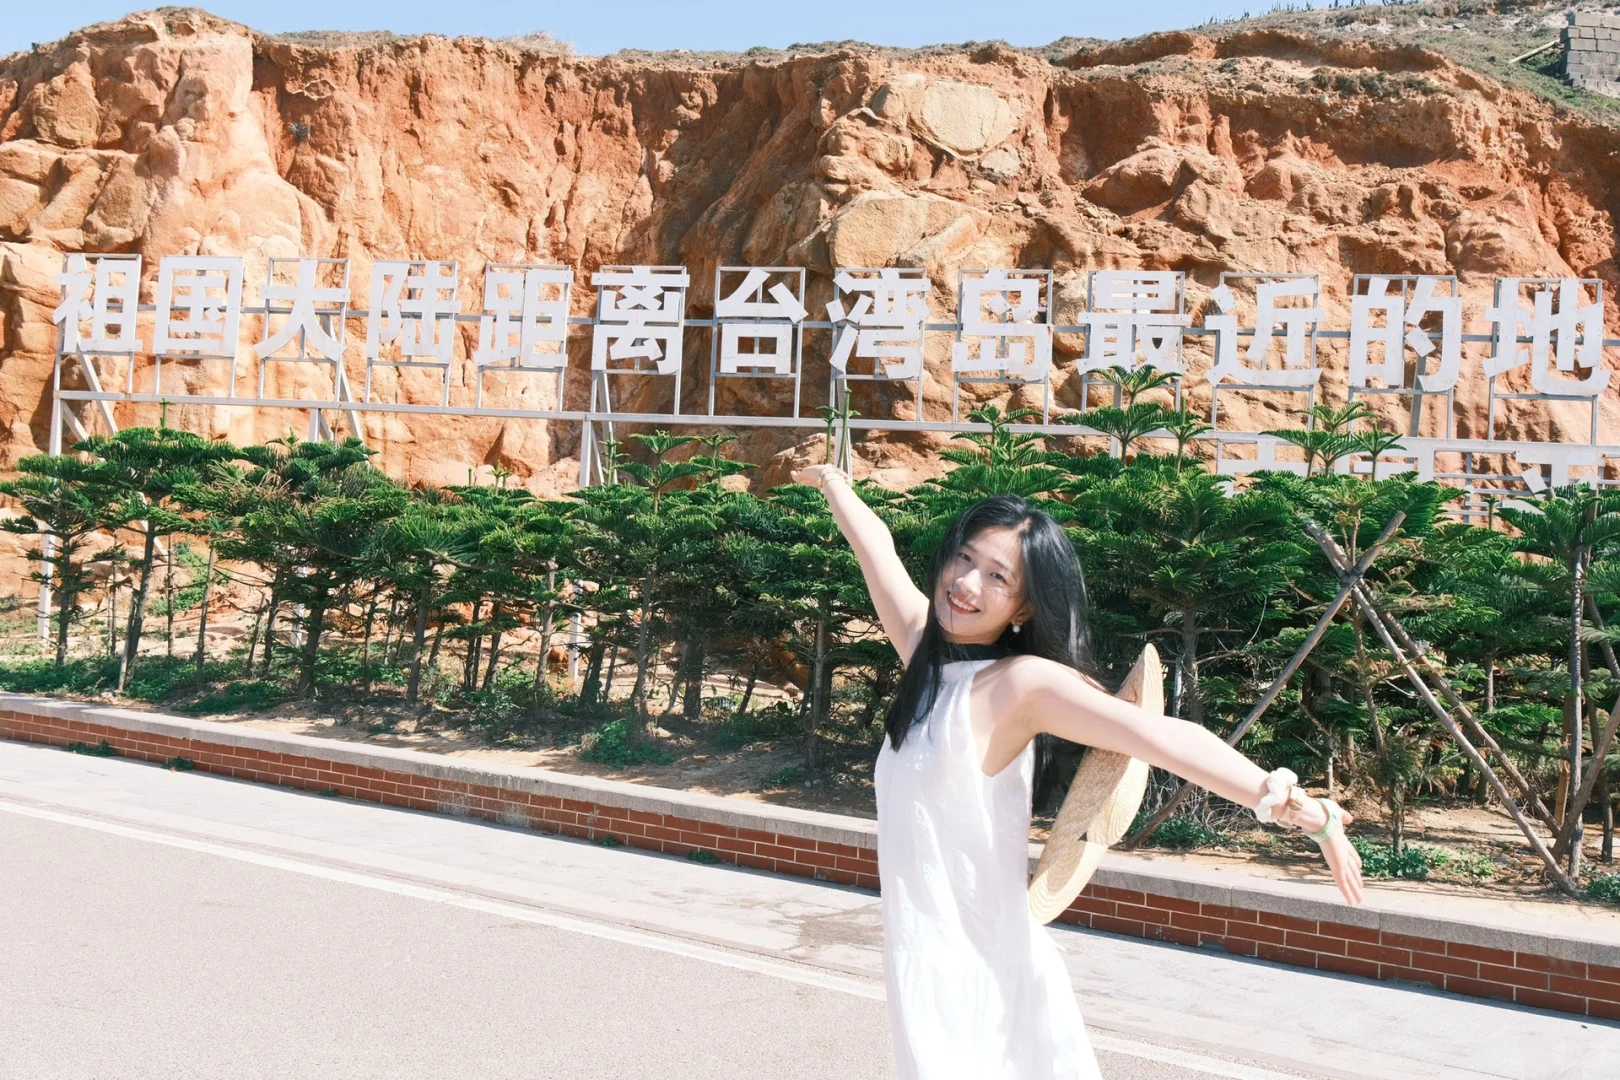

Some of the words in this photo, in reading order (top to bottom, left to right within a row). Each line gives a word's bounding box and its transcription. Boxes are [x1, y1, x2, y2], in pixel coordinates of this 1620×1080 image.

[53, 253, 1610, 397] 祖国大陆距离台湾岛最近的地
